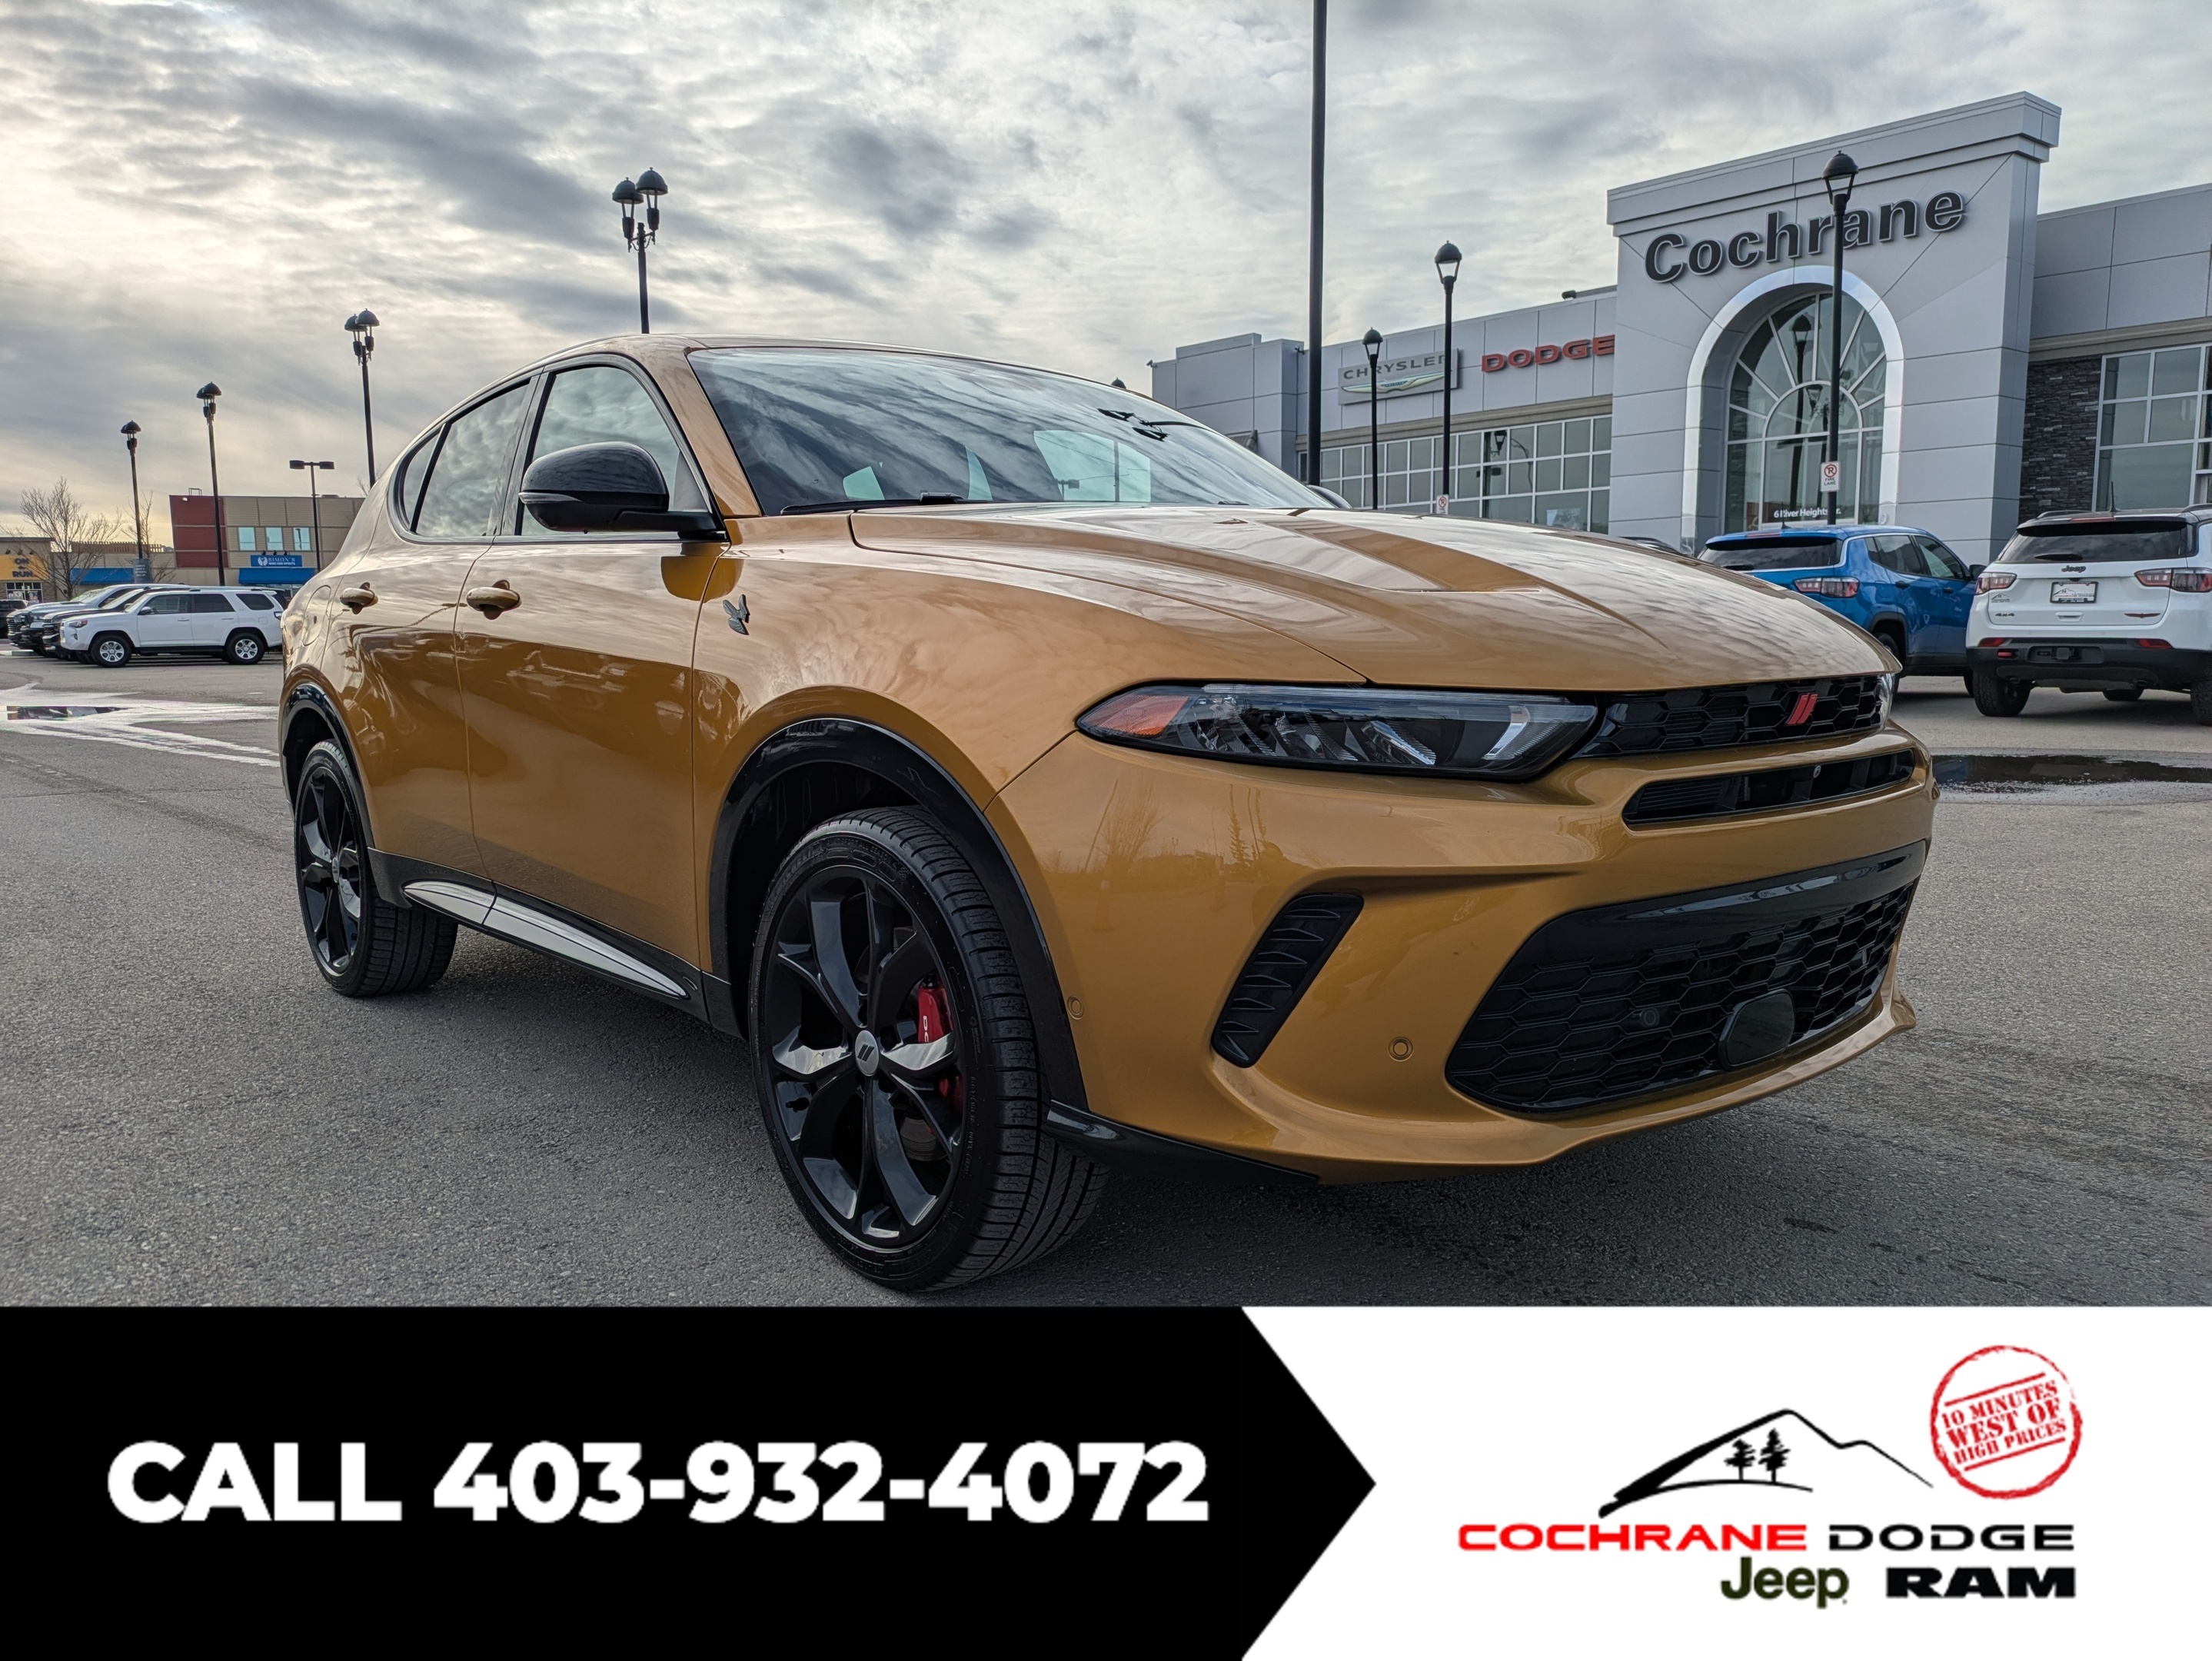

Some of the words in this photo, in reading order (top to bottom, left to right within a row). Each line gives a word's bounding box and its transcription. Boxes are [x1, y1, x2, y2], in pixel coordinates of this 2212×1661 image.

[1645, 190, 1965, 283] Cochrane
[1482, 335, 1615, 372] DODGE
[1773, 510, 1779, 518] 6
[1780, 508, 1799, 518] River
[1800, 507, 1828, 518] Heights
